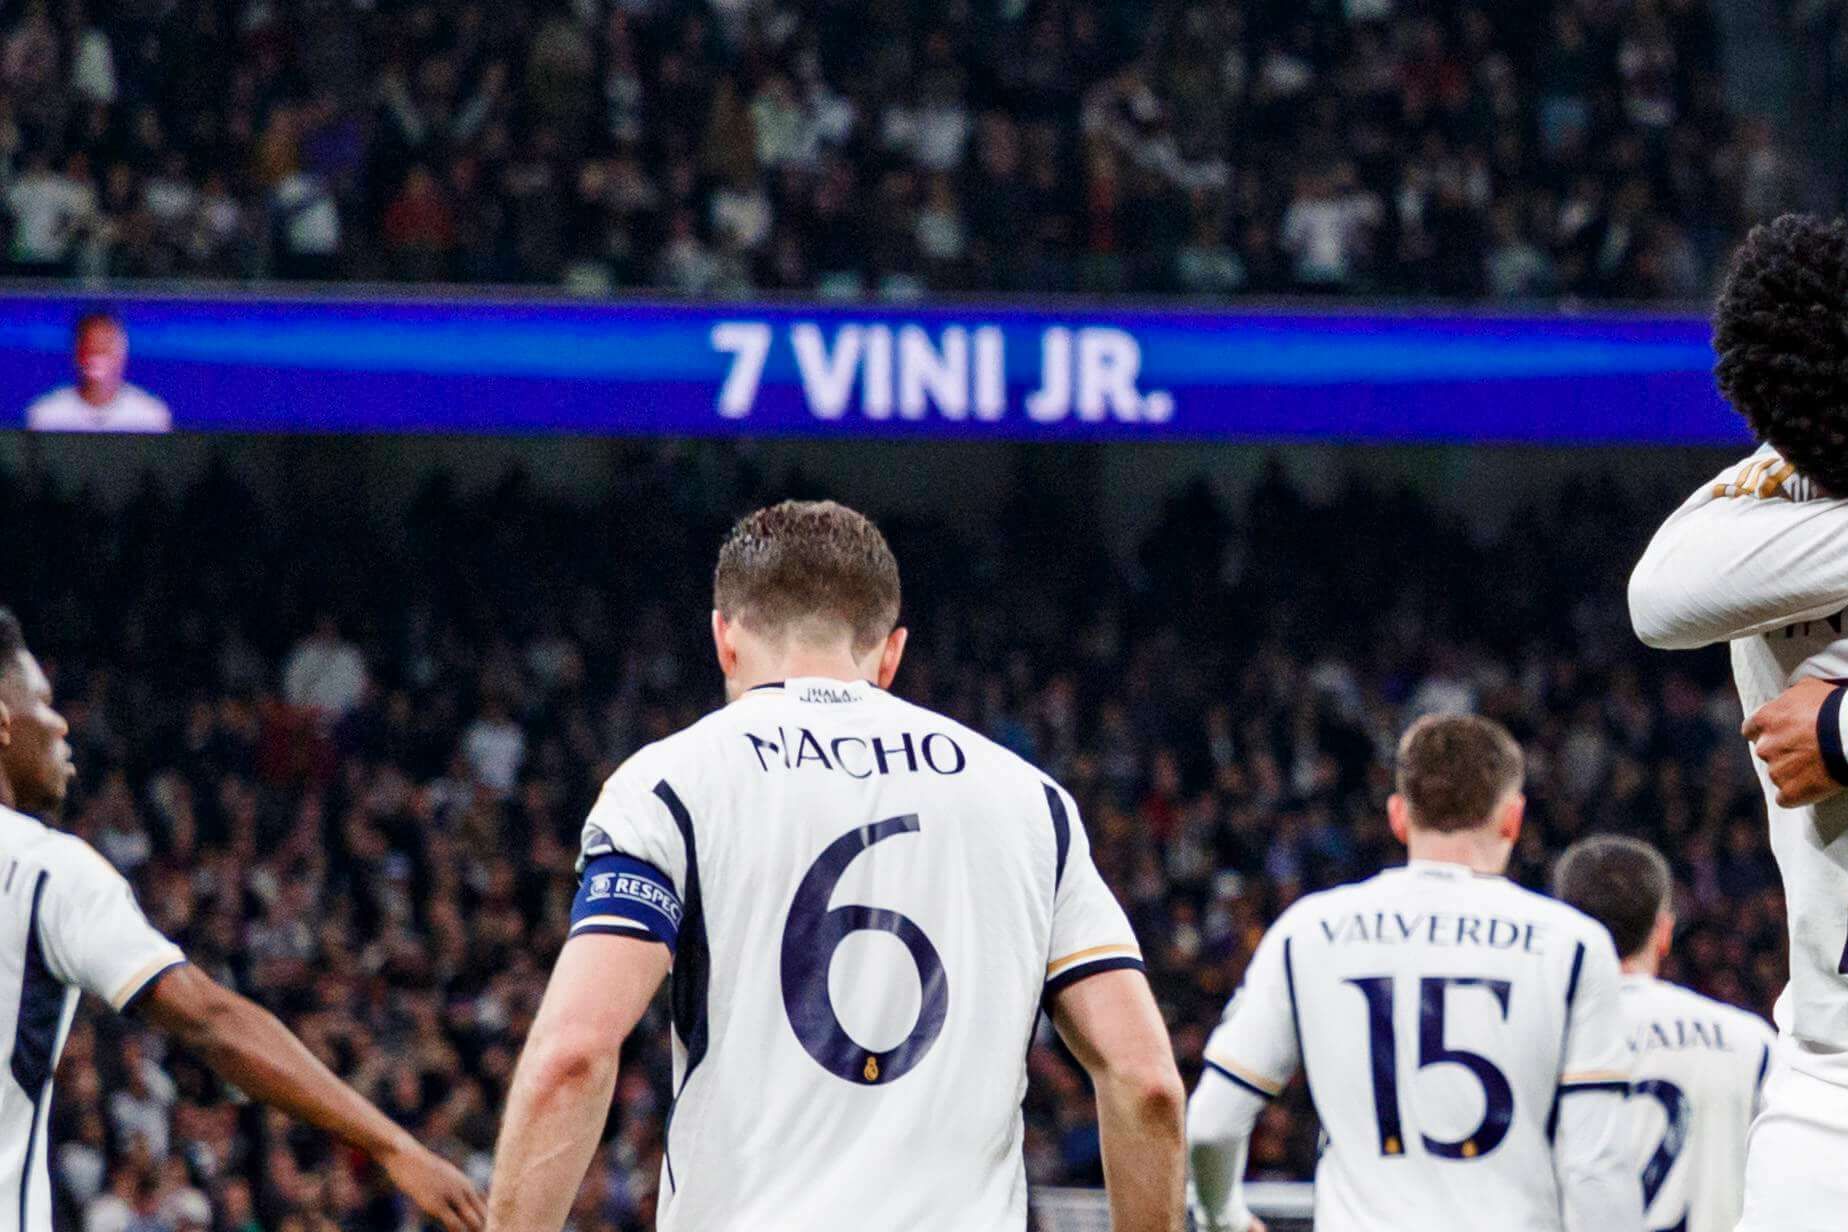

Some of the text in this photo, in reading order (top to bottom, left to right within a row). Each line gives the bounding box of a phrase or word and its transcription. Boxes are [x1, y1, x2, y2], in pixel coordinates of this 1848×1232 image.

[711, 323, 1175, 423] 7 VINI JR.
[744, 726, 966, 779] NACHO
[780, 812, 949, 1086] 6
[1320, 911, 1546, 955] VALVERDE
[1340, 975, 1515, 1160] 15
